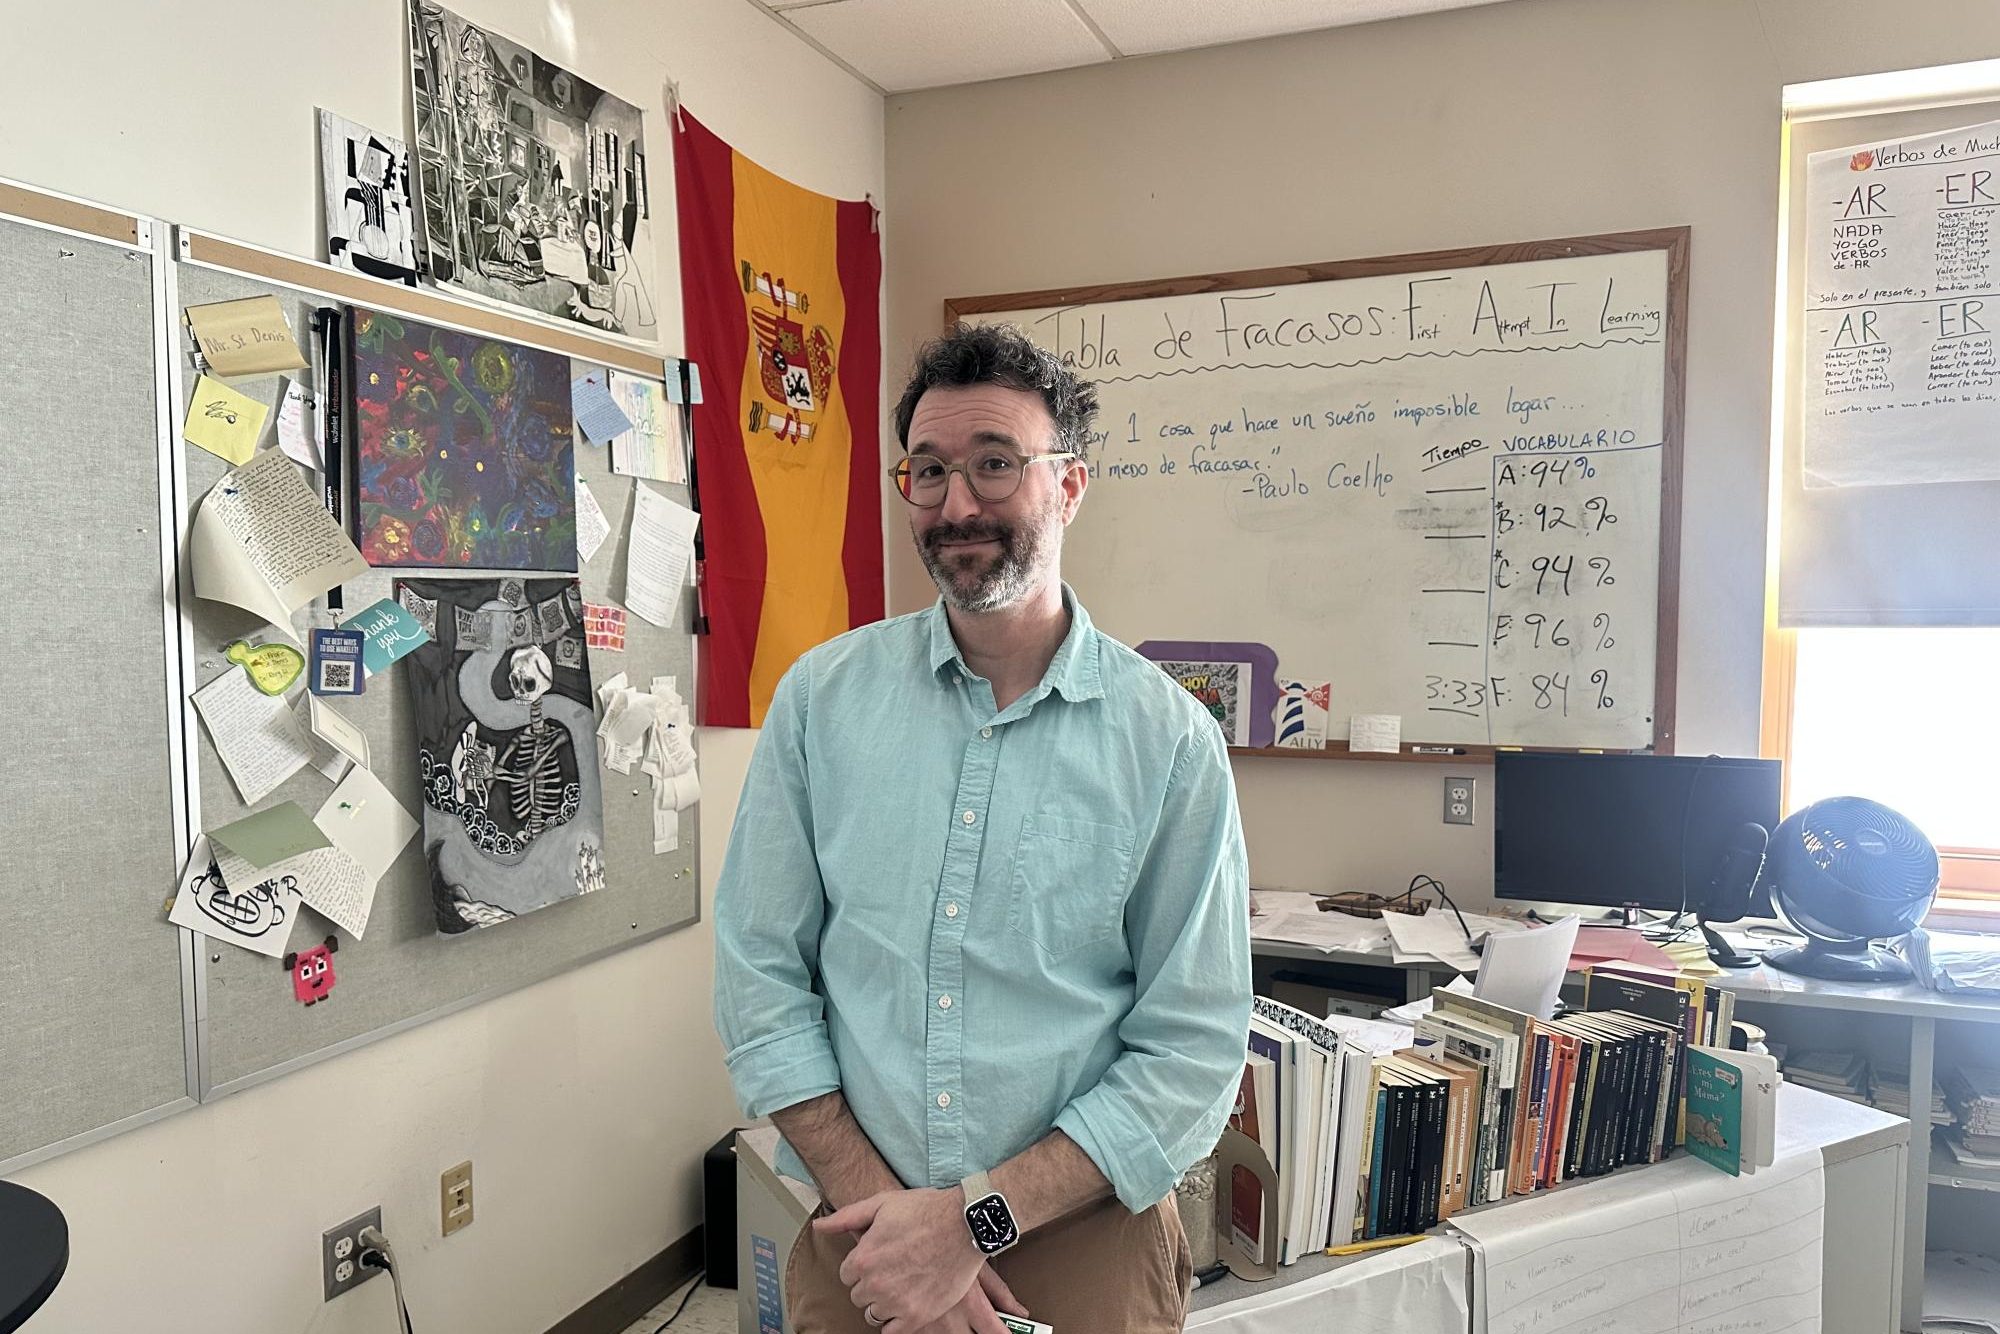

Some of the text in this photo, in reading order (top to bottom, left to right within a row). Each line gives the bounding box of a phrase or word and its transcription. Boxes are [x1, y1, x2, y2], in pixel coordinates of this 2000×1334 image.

[1876, 143, 1925, 167] Verbos
[1933, 143, 1957, 159] de
[1833, 224, 1883, 238] NADA
[1830, 248, 1887, 261] VERBOS
[1833, 260, 1846, 270] de
[1842, 293, 1853, 302] en
[1034, 304, 1121, 370] Tabla
[1154, 312, 1193, 359] de
[1402, 277, 1452, 341] First
[1526, 281, 1577, 336] In
[1600, 277, 1660, 336] Learning
[250, 327, 286, 344] Denis
[1127, 412, 1140, 443] 1
[1159, 423, 1195, 438] cosa
[1209, 419, 1233, 450] que
[1241, 407, 1281, 433] hace
[1292, 412, 1316, 430] un
[1325, 400, 1375, 428] sueño
[1393, 392, 1481, 426] imposible
[1421, 438, 1483, 465] Tiempo
[1502, 429, 1637, 452] VOCABULARIO
[1159, 453, 1177, 475] de
[1327, 452, 1394, 498] Coelho
[376, 626, 413, 659] you
[1425, 674, 1487, 708] 3:33
